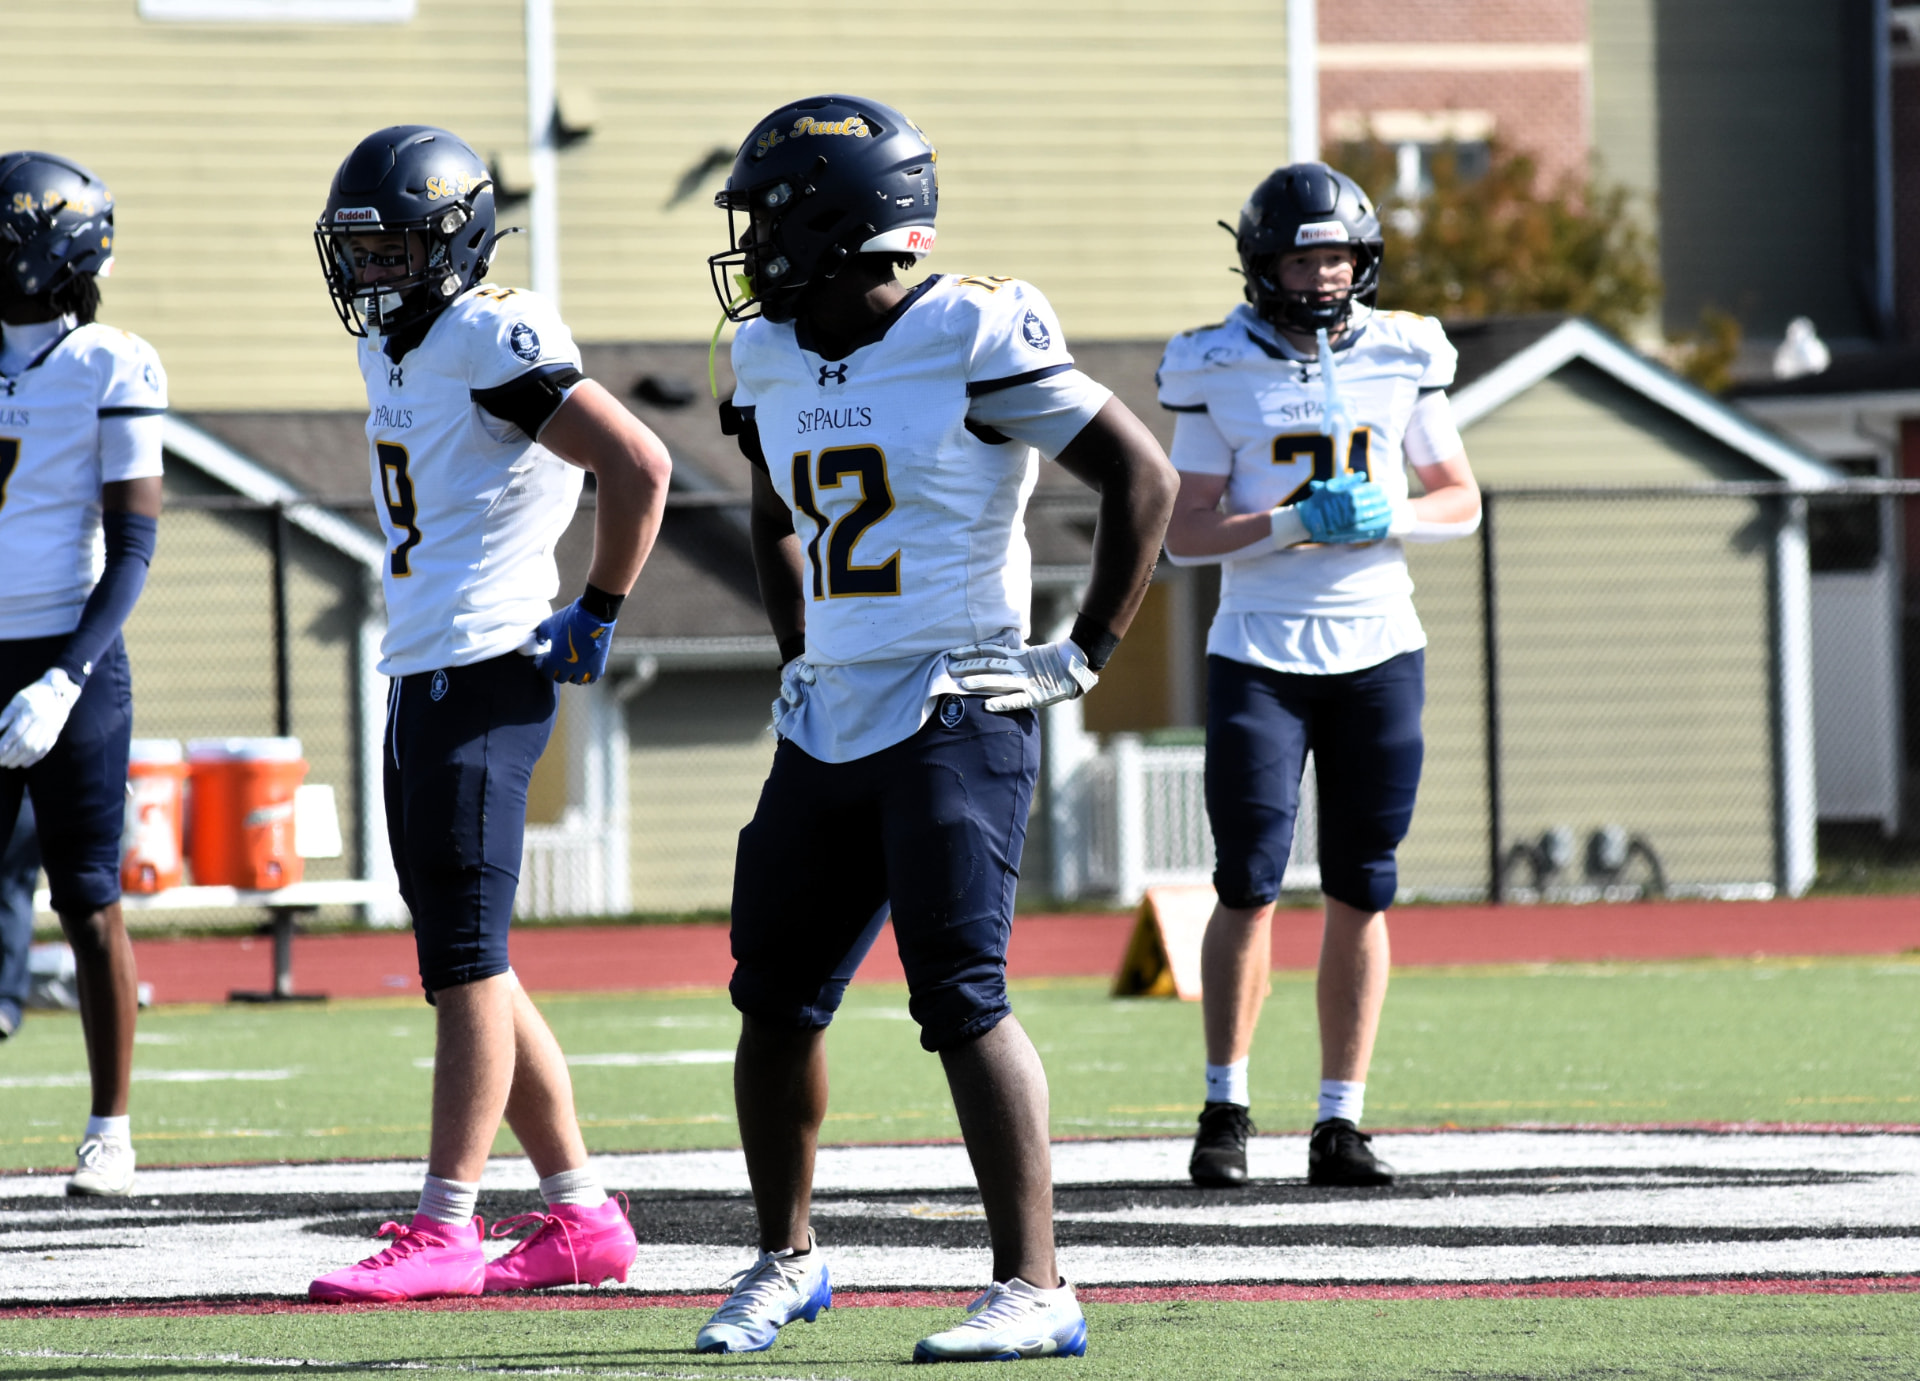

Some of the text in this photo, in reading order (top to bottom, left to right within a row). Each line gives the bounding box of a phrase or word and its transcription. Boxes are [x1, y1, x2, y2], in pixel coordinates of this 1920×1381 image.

[757, 116, 869, 157] St. Paul's
[426, 176, 456, 200] St.
[337, 210, 372, 221] Riddell
[376, 439, 423, 579] 9
[791, 443, 902, 602] 12
